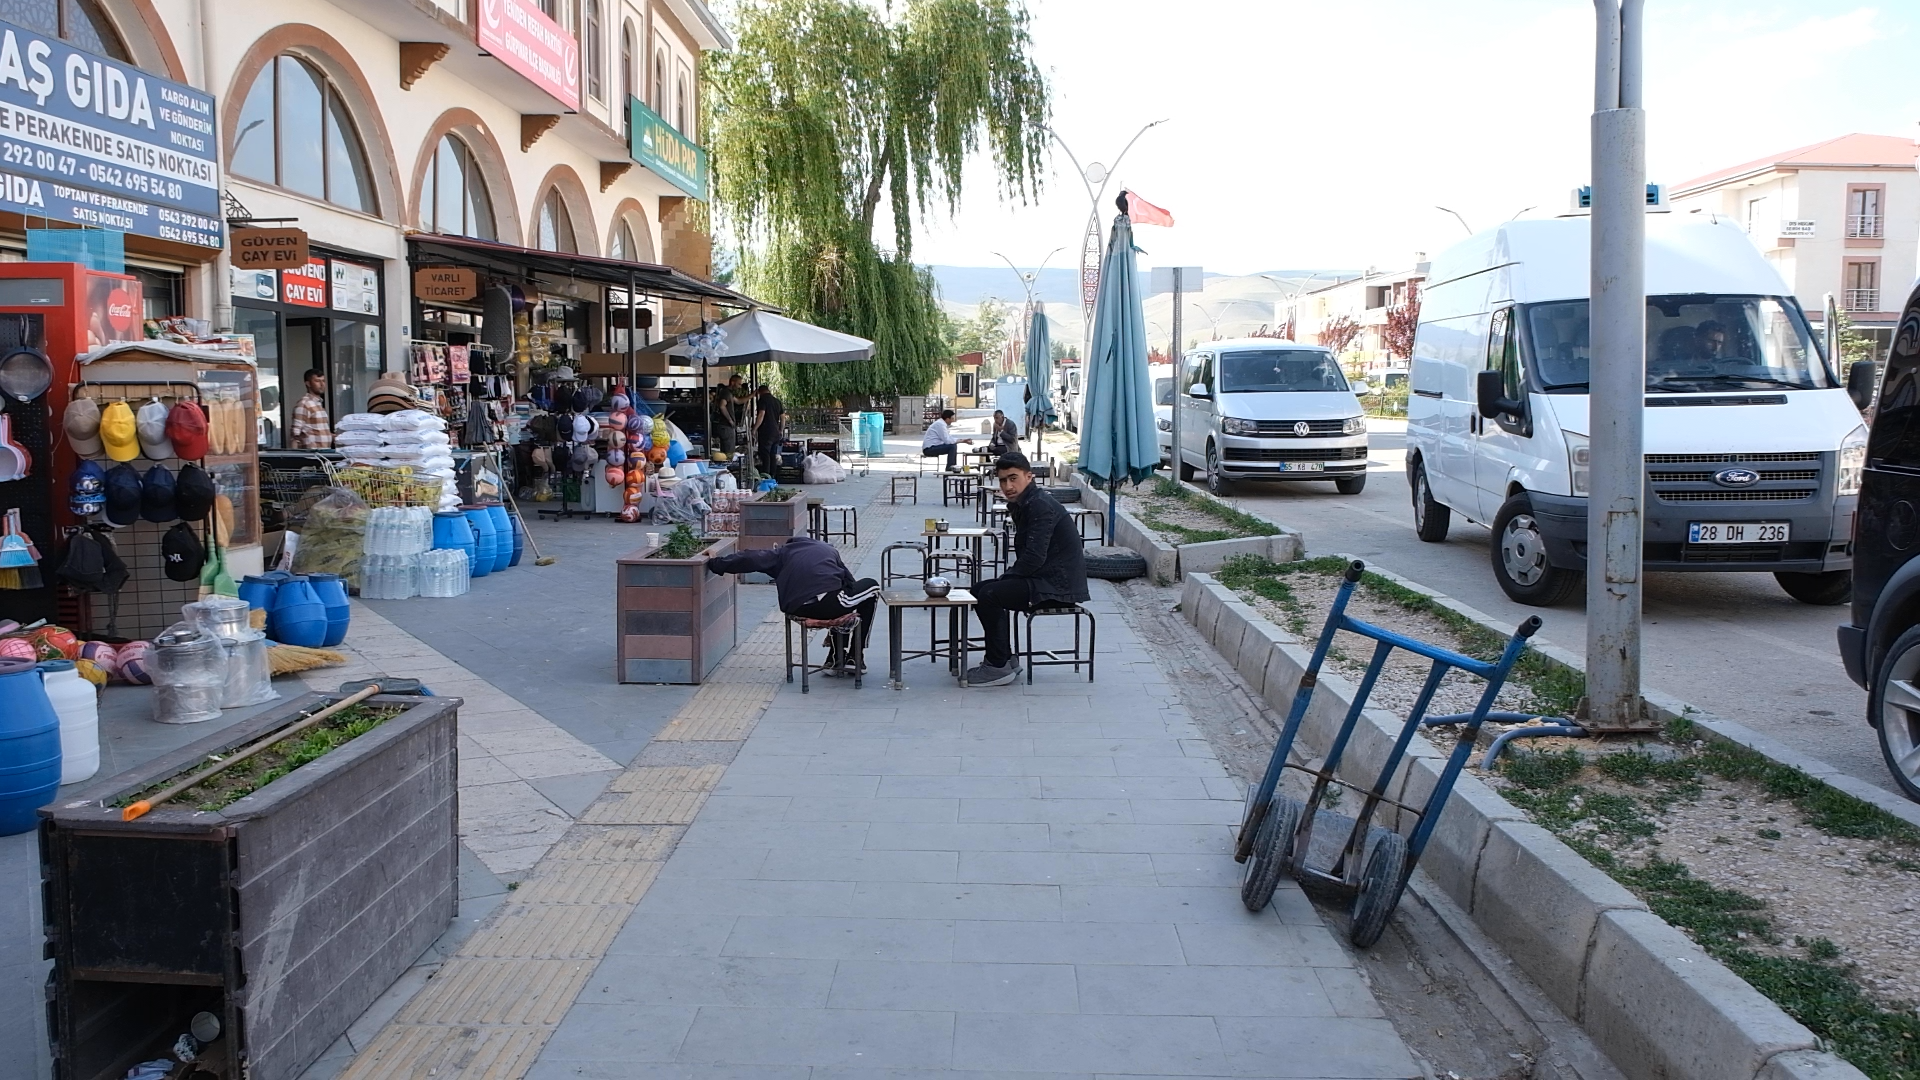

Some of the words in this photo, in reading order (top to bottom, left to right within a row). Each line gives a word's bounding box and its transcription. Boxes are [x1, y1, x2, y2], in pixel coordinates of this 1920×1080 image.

[527, 14, 544, 43] REFAH
[65, 53, 155, 130] GIDA
[161, 87, 189, 108] KARGO
[190, 97, 209, 115] ALIM
[160, 107, 171, 121] VE
[172, 110, 212, 135] GÖNDERİM
[16, 113, 112, 154] PERAKENDE
[116, 141, 155, 169] SATIŞ
[159, 154, 211, 182] NOKTASI
[171, 131, 204, 152] NOKTASI
[4, 142, 33, 167] 292
[37, 151, 55, 171] 00
[59, 157, 76, 176] 47
[90, 164, 123, 187] 0542
[126, 172, 148, 193] 695
[151, 178, 166, 196] 54
[169, 183, 182, 200] 80
[681, 143, 697, 181] PAR
[53, 185, 88, 204] TOPTAN
[89, 193, 100, 206] VE
[101, 195, 148, 216] PERAKENDE
[73, 207, 97, 224] SATIŞ
[99, 212, 133, 229] NOKTASI
[159, 209, 180, 223] 0543
[182, 213, 197, 226] 292
[198, 217, 208, 229] 00
[210, 220, 219, 232] 47
[160, 226, 181, 240] 0542
[182, 231, 197, 242] 695
[198, 233, 209, 245] 54
[210, 236, 220, 247] 80
[241, 236, 298, 247] GÜVEN
[241, 250, 268, 264] ÇAY
[431, 273, 460, 283] VARLI
[286, 283, 305, 303] ÇAY
[307, 285, 322, 303] EVİ
[425, 285, 466, 296] TİCARET
[1726, 472, 1750, 482] Ford
[1701, 525, 1717, 541] 28
[1726, 525, 1744, 541] DH
[1759, 525, 1785, 541] 236
